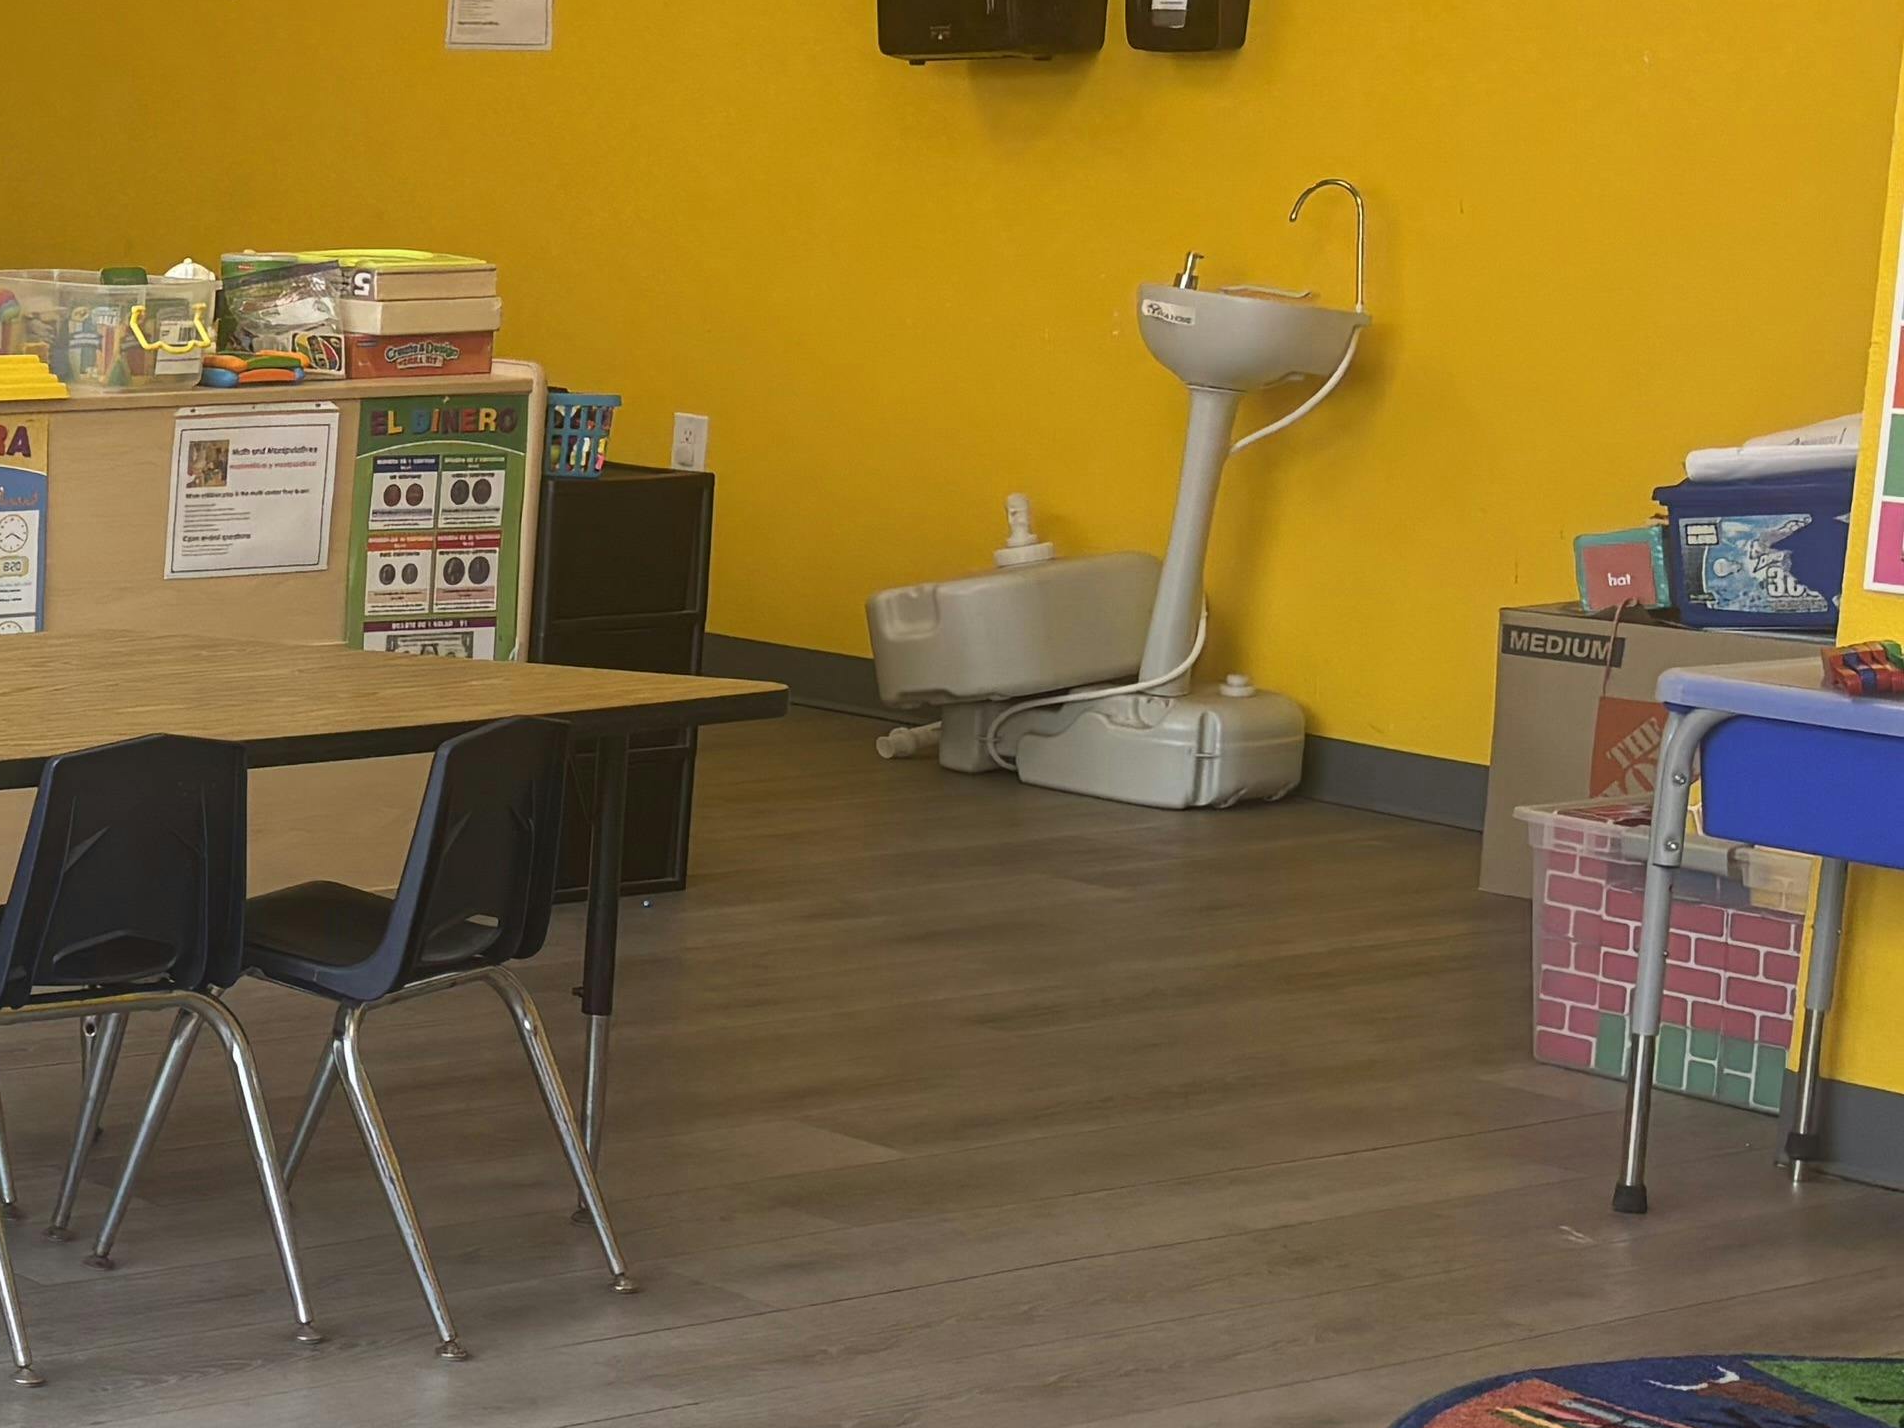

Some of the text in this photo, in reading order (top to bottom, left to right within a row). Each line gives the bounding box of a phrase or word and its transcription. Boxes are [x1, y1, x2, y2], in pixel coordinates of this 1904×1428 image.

[354, 272, 372, 296] 5
[371, 408, 518, 436] EL DINERO
[1608, 572, 1631, 587] hat
[1509, 630, 1613, 660] MEDIUM
[1606, 717, 1661, 770] THE
